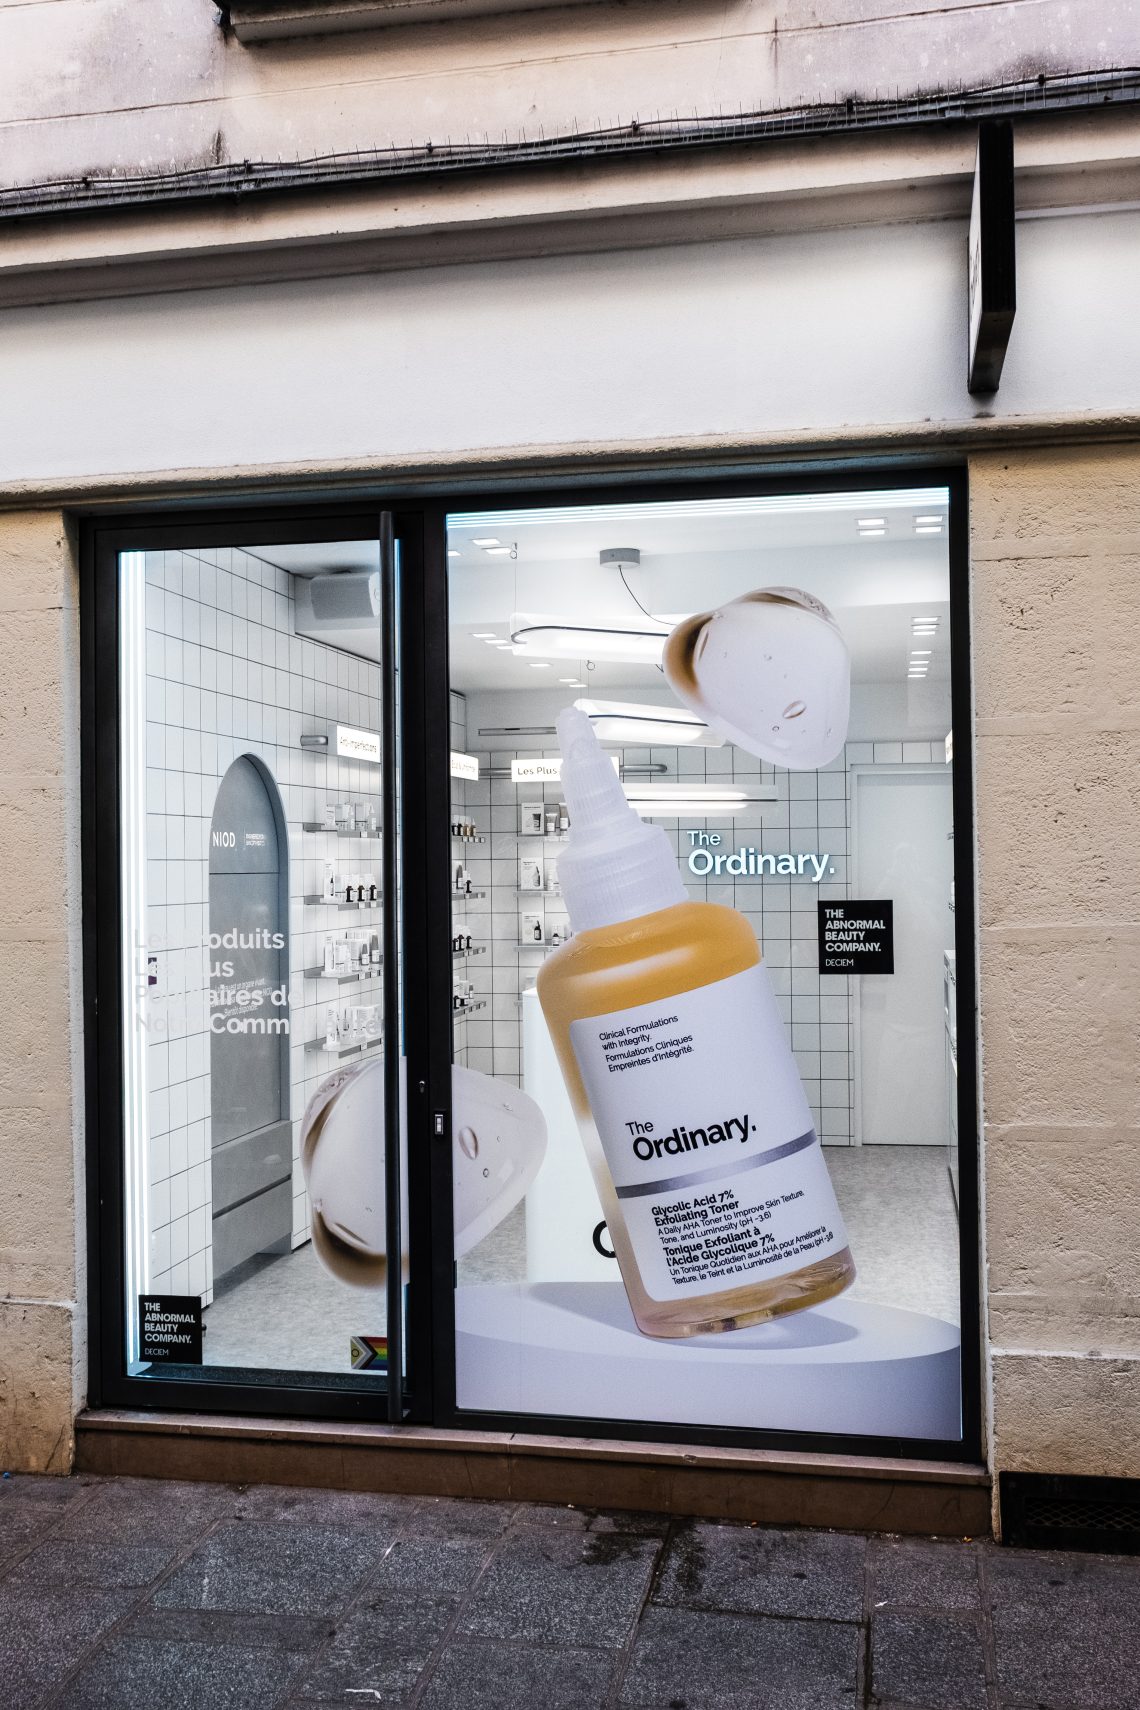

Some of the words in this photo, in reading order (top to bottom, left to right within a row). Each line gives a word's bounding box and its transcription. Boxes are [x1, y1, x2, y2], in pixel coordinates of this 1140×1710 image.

[517, 767, 534, 775] Les
[536, 766, 558, 775] Plus
[212, 831, 235, 847] NIOD
[687, 830, 721, 846] The
[688, 848, 835, 882] Ordinary.
[825, 908, 844, 918] THE
[825, 920, 886, 929] ABNORMAL
[825, 931, 865, 940] BEAUTY
[826, 942, 882, 952] COMPANY.
[599, 1028, 626, 1041] Clinical
[626, 1015, 679, 1034] Formulations
[602, 1040, 618, 1050] with
[606, 1046, 654, 1062] Formulations
[655, 1034, 693, 1050] Cliniques
[608, 1057, 651, 1072] Empreintes
[625, 1121, 654, 1136] The
[633, 1114, 756, 1160] Ordinary.
[652, 1201, 691, 1216] Glycolic
[694, 1194, 717, 1208] Acid
[718, 1189, 734, 1202] 7%
[654, 1209, 708, 1226] Exfoliating
[708, 1200, 739, 1214] Toner
[664, 1226, 682, 1234] Daily
[683, 1222, 700, 1231] AHA
[700, 1216, 723, 1227] Toner
[734, 1204, 764, 1218] Improve
[765, 1199, 780, 1209] Skin
[681, 1232, 695, 1241] and
[696, 1222, 738, 1238] Luminosity
[739, 1217, 753, 1228] (pH
[663, 1243, 703, 1256] Tonique
[704, 1229, 752, 1248] Exfoliant
[754, 1226, 761, 1235] à
[666, 1254, 699, 1267] l'Acide
[701, 1240, 758, 1260] Glycolique
[759, 1233, 775, 1246] 7%
[680, 1264, 709, 1274] Tonique
[710, 1254, 746, 1268] Quotidien
[747, 1251, 762, 1259] aux
[762, 1244, 779, 1255] AHA
[779, 1239, 795, 1251] pour
[707, 1269, 726, 1278] Teint
[744, 1252, 782, 1269] Luminosité
[784, 1249, 793, 1257] de
[800, 1242, 815, 1252] Peau
[144, 1302, 161, 1311] THE
[145, 1313, 195, 1323] ABNORMAL
[144, 1323, 178, 1332] BEAUTY
[145, 1333, 192, 1344] COMPANY.
